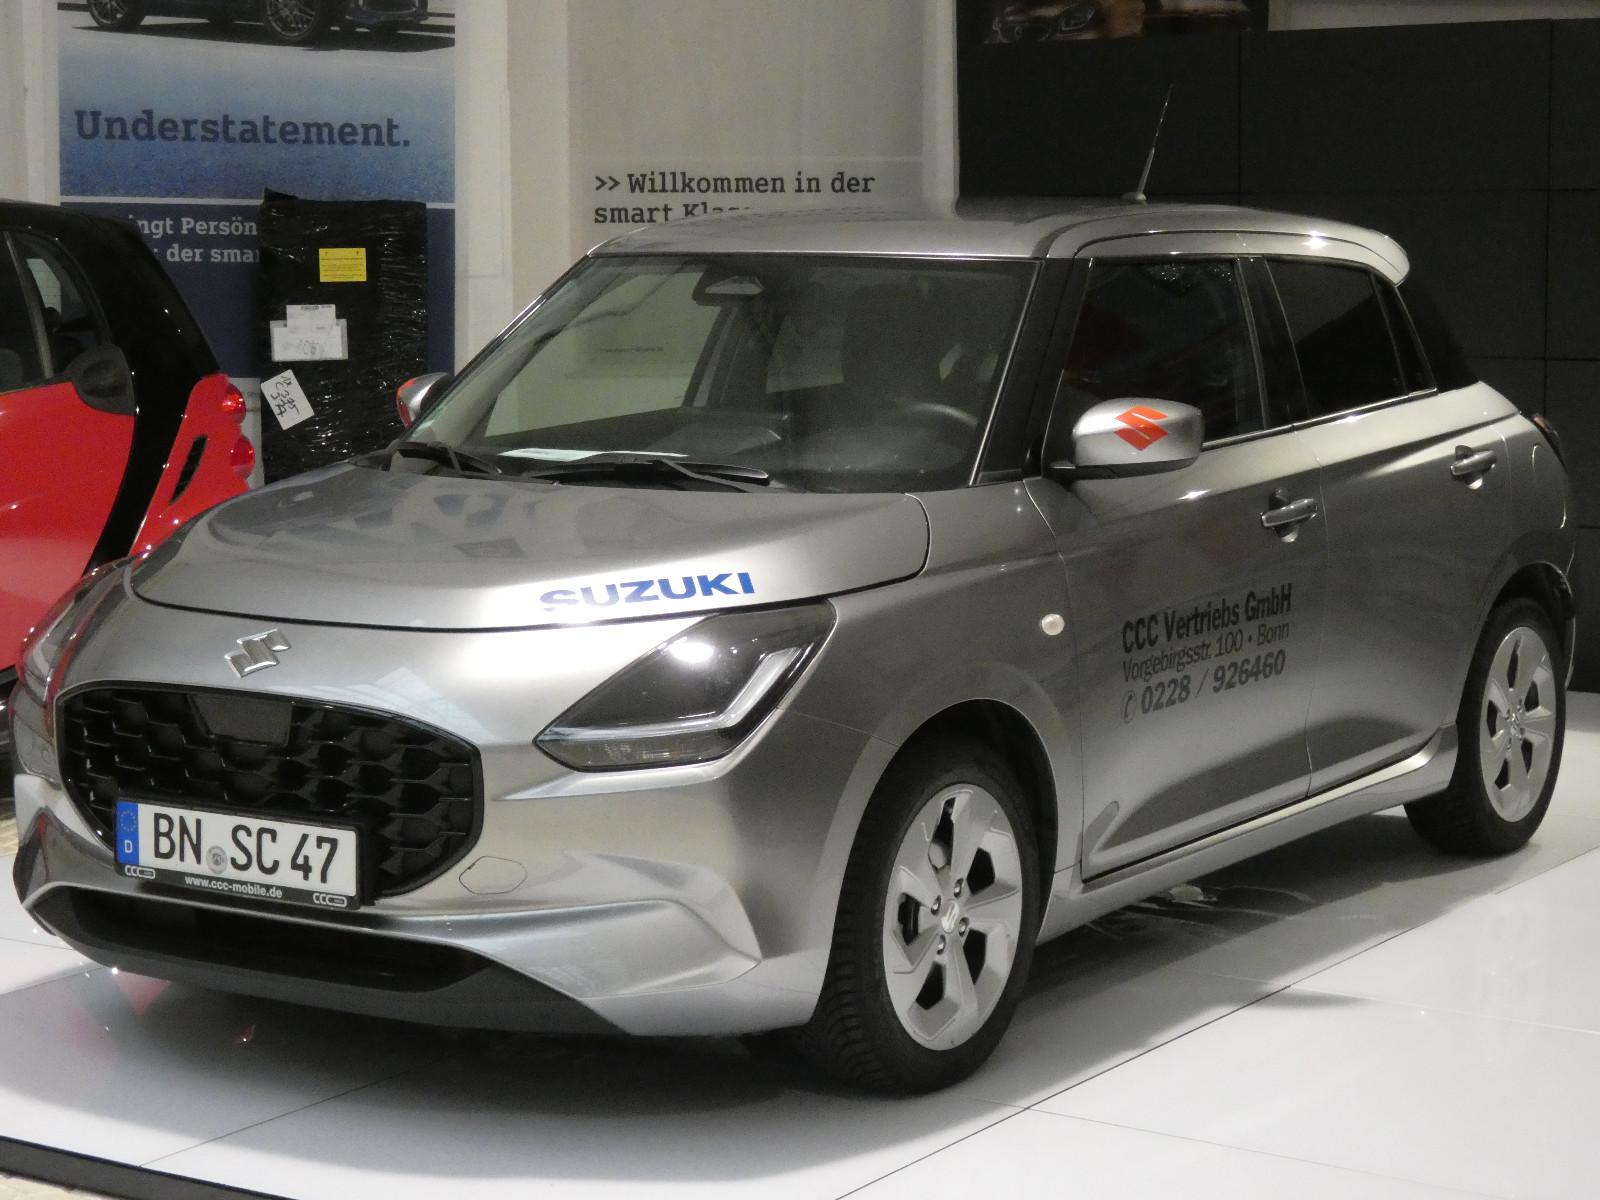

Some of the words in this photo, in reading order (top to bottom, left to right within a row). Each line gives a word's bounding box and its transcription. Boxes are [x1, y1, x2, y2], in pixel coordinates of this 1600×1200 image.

[74, 109, 411, 148] Understatement.
[627, 171, 786, 194] Willkommen
[794, 171, 821, 194] in
[830, 171, 876, 194] der
[594, 203, 673, 224] smart
[166, 243, 204, 262] der
[539, 571, 756, 613] SUZUKI
[1122, 613, 1159, 654] CCC
[1163, 598, 1240, 643] Vertriebs
[1244, 582, 1293, 623] GmbH
[1122, 640, 1213, 683] Vorgebirgsstr.
[1214, 628, 1244, 658] 100
[1257, 622, 1290, 647] Bonn
[1141, 674, 1192, 715] 0228
[1212, 649, 1287, 694] 926460
[124, 840, 133, 853] D
[153, 812, 202, 865] BN
[230, 824, 280, 876] SC
[290, 833, 339, 884] 47
[184, 875, 283, 899] www.ccc-mobile.de
